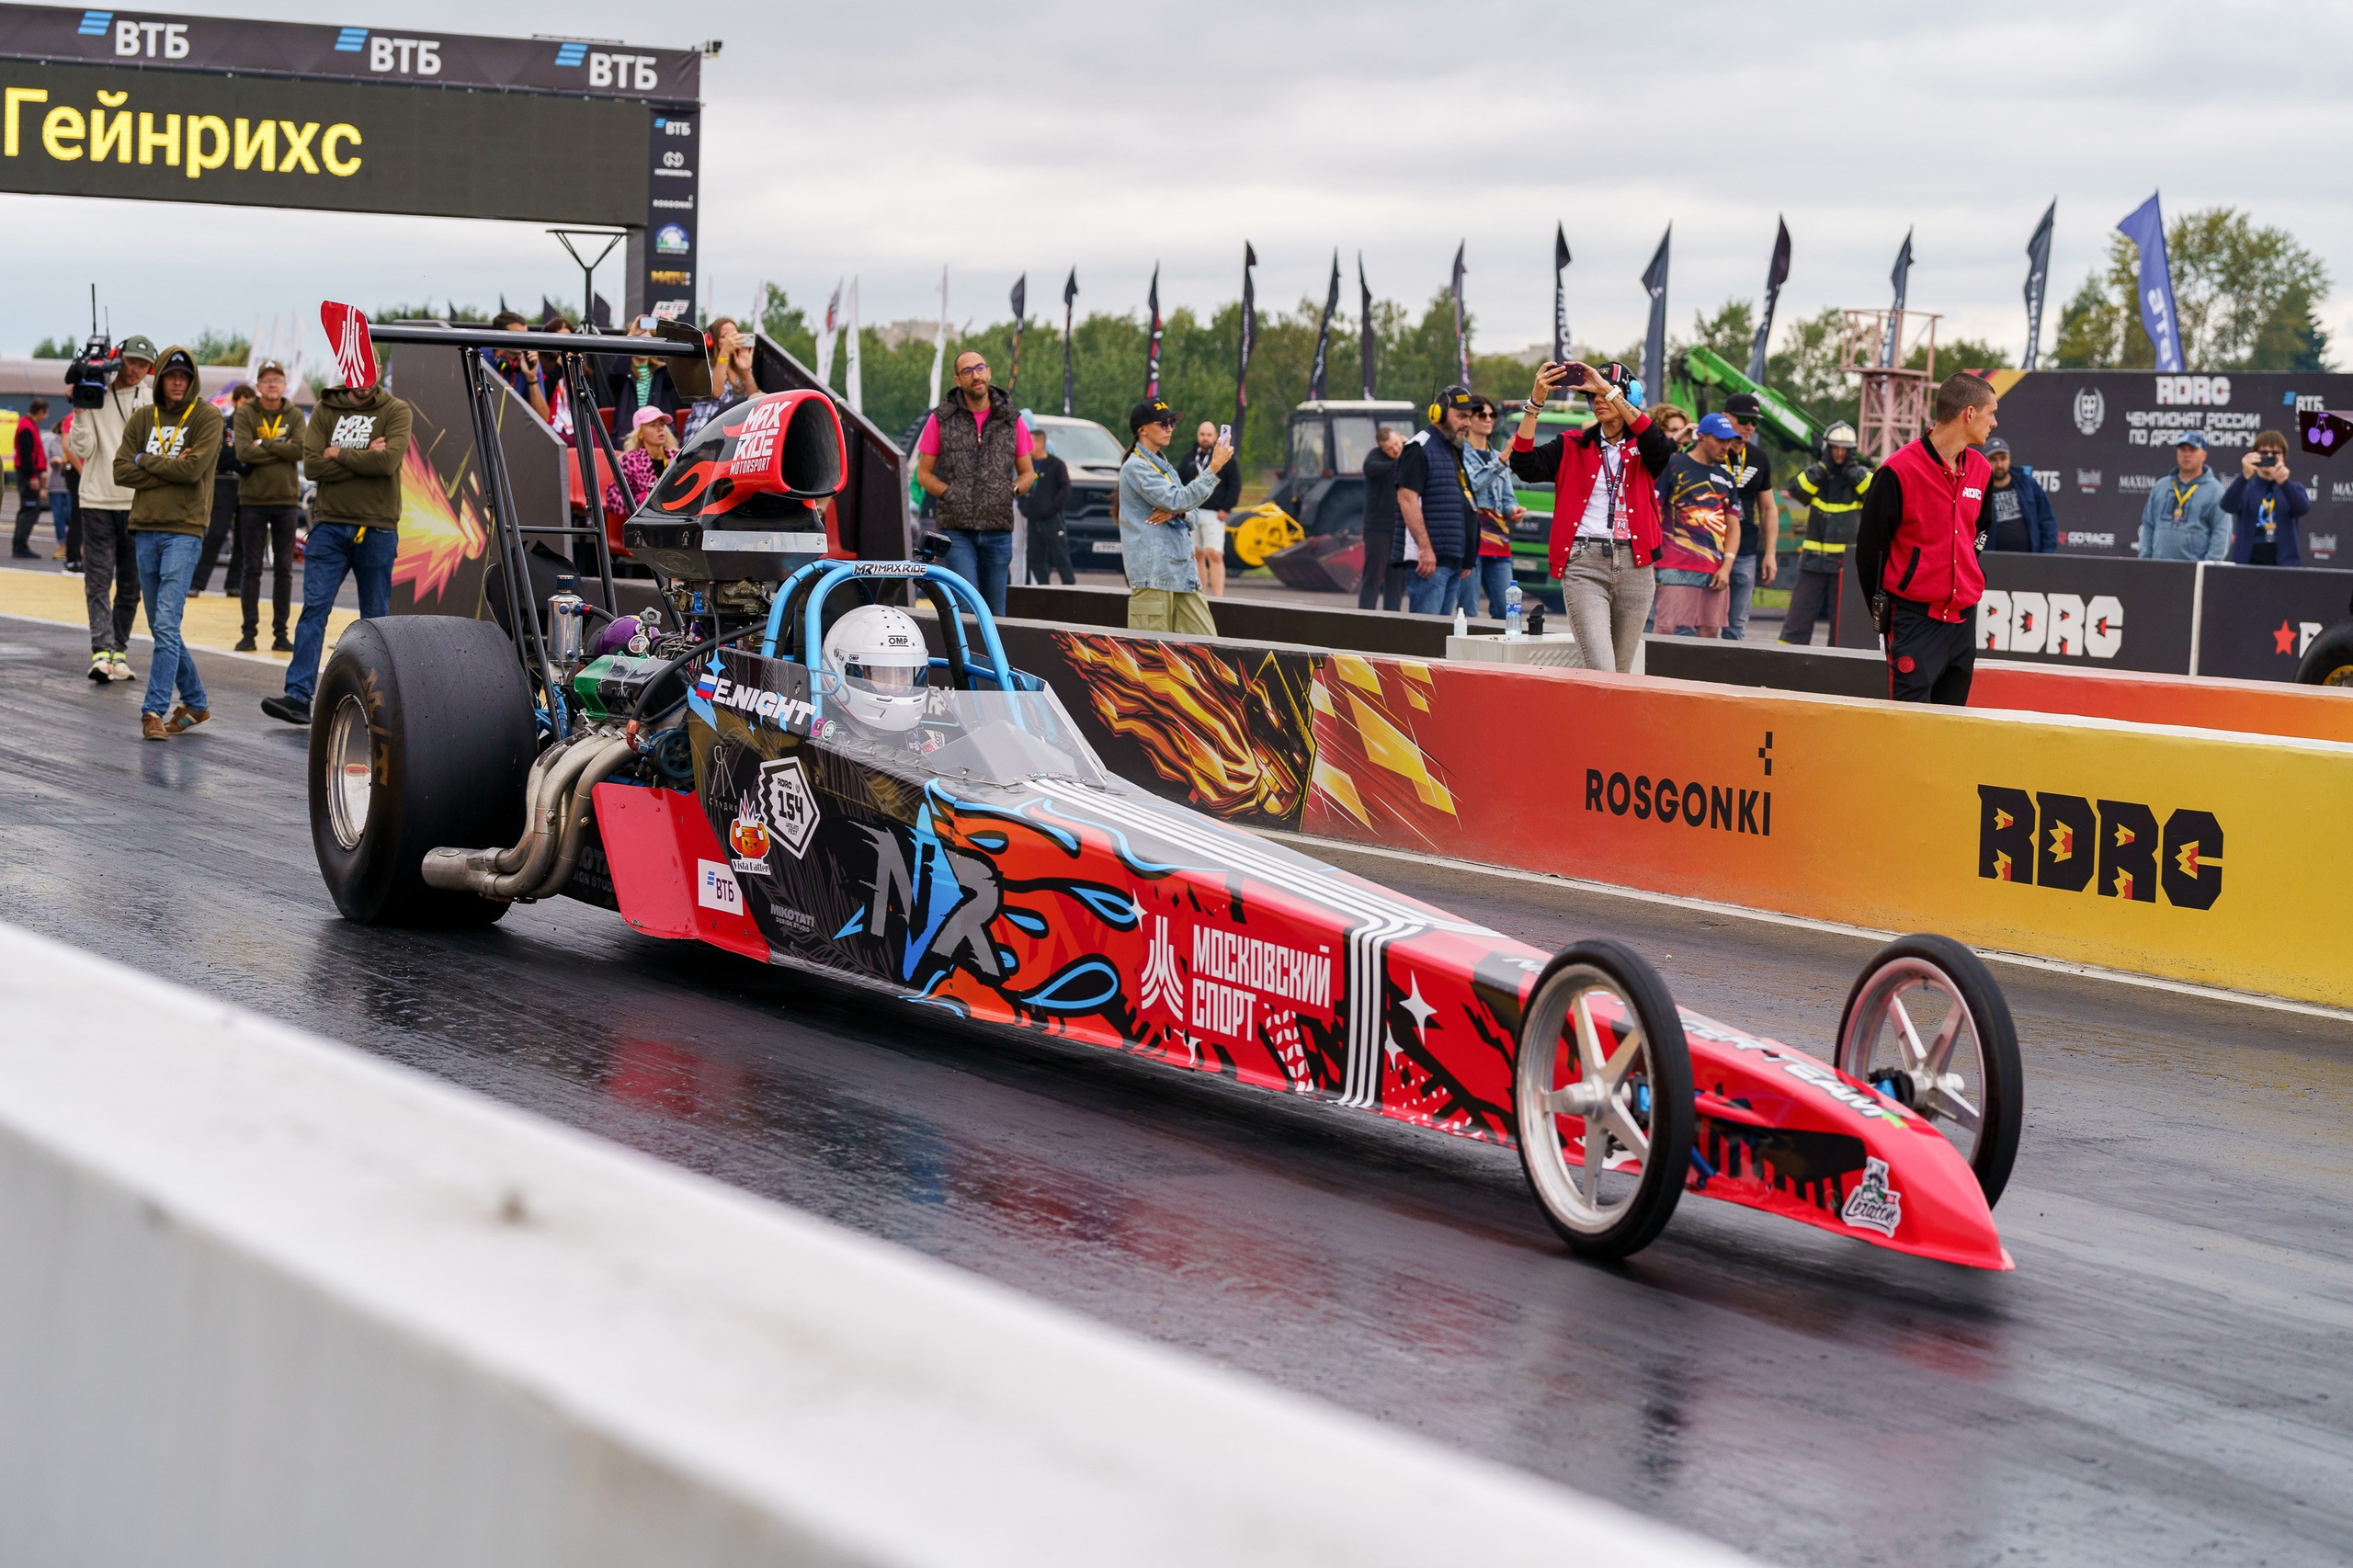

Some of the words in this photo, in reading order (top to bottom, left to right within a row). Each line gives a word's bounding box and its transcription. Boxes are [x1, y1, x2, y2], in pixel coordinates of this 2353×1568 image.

[115, 20, 190, 59] ВТБ
[369, 36, 442, 75] ВТБ
[589, 52, 658, 90] ВТБ
[4, 87, 363, 179] Гейнрихс
[665, 120, 691, 136] ВТБ
[2155, 376, 2231, 405] RDRC
[335, 415, 377, 429] MAX
[741, 401, 792, 433] MAX
[2125, 411, 2204, 428] ЧЕМПИОНАТ
[2205, 412, 2261, 429] РОССИИ
[2128, 428, 2147, 445] ПО
[729, 457, 771, 476] MOTORSPORT
[888, 637, 909, 645] OMP
[1975, 589, 2124, 659] RDRC
[712, 677, 817, 725] E.NIGHT
[778, 790, 804, 824] 154
[1586, 768, 1771, 837] ROSGONKI
[1978, 784, 2225, 911] RDRC
[716, 878, 734, 903] ВТБ
[770, 903, 815, 927] MIKOTATI
[1192, 924, 1331, 1008] МОСКОВСКИЙ
[1192, 977, 1256, 1041] СПОРТ
